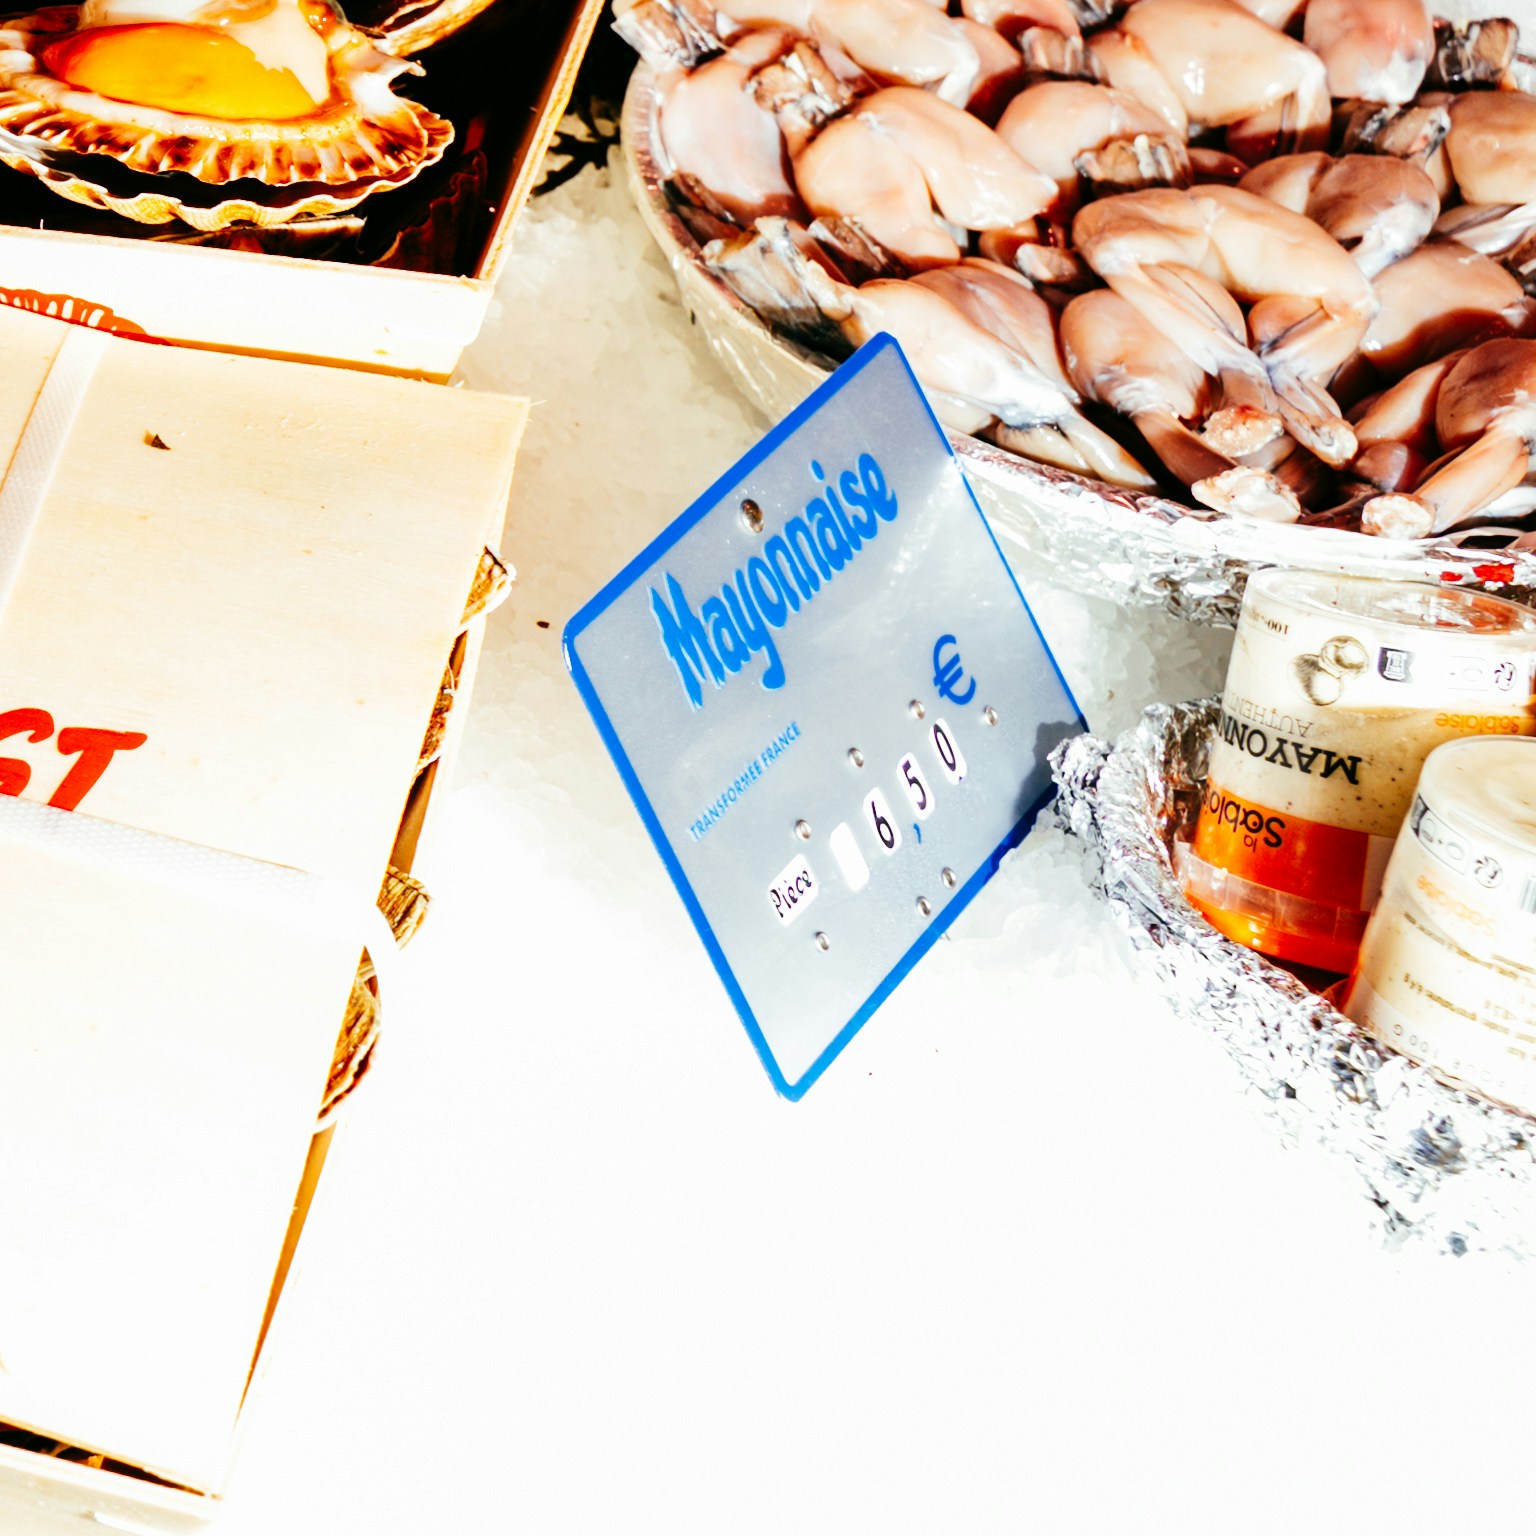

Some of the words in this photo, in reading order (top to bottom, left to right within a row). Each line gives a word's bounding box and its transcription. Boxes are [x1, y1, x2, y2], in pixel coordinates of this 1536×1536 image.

[648, 452, 899, 712] Mayonnaise
[689, 759, 764, 841] TRANSFORMEE
[760, 720, 801, 768] FRANCE
